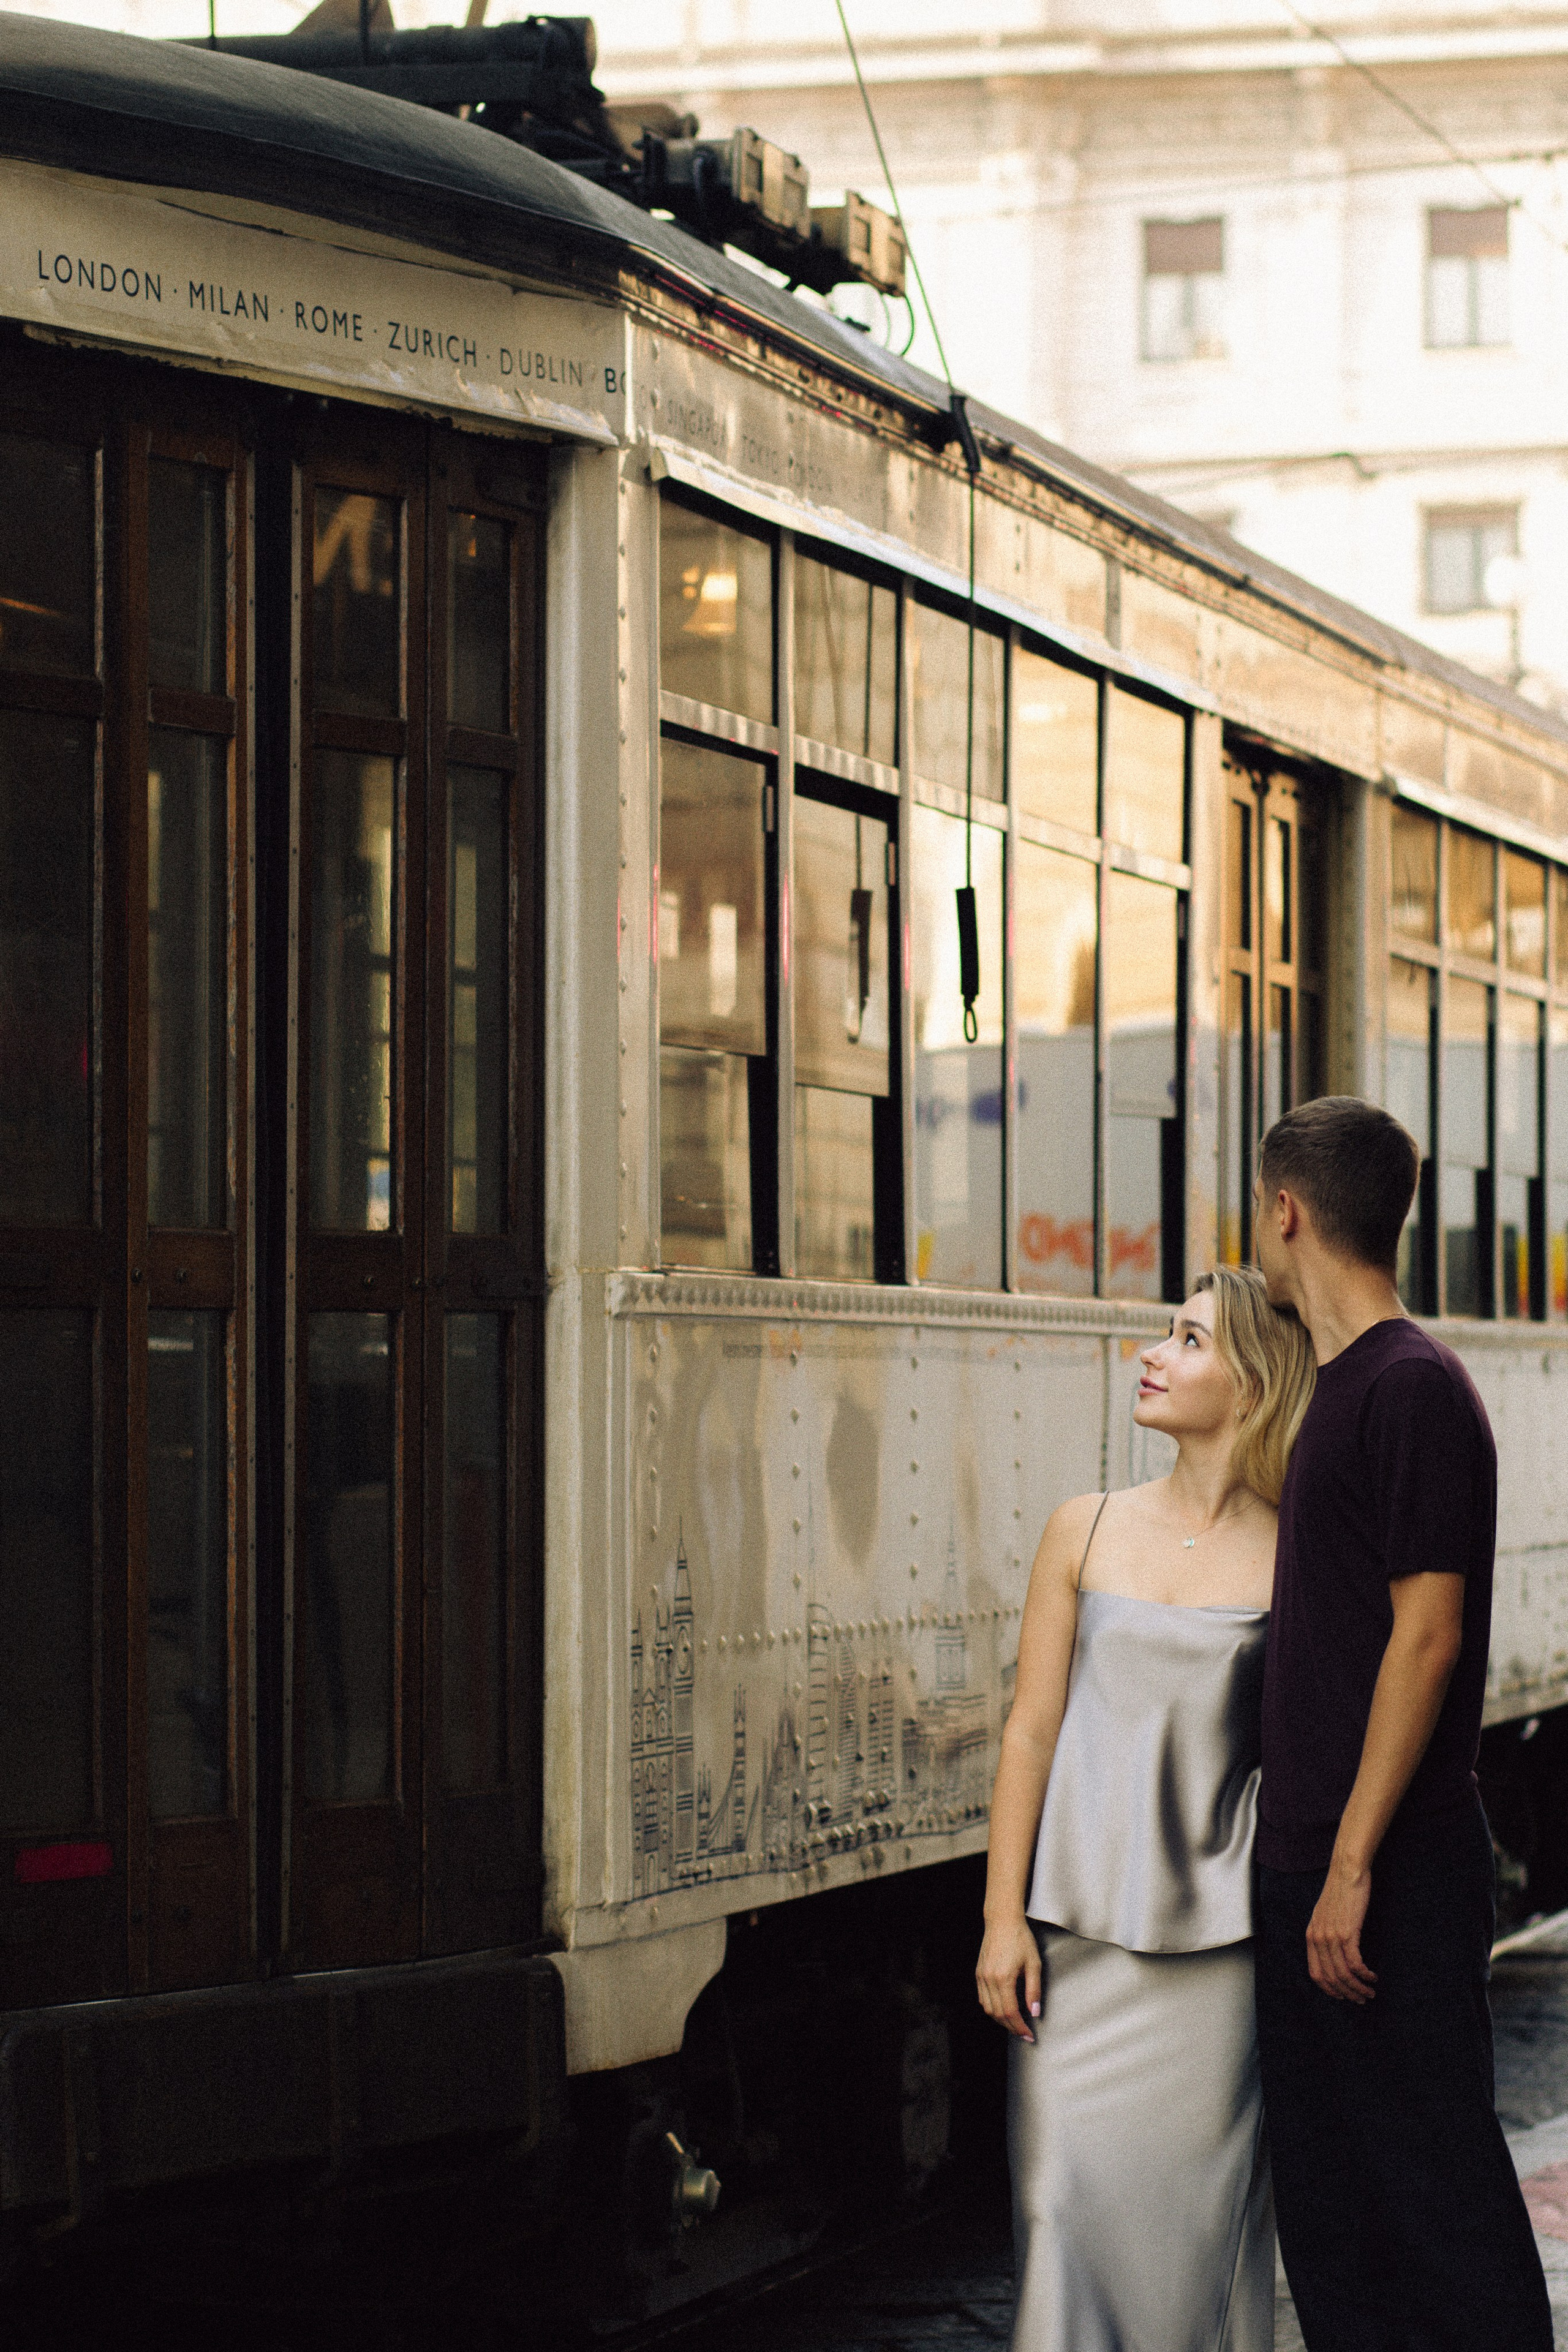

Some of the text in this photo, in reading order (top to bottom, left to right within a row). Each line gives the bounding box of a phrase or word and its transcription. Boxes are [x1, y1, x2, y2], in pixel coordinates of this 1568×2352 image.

[38, 249, 162, 303] LONDON
[189, 280, 269, 323] MILAN
[295, 301, 363, 342] ROME
[387, 320, 478, 368] ZURICH
[499, 347, 583, 388] DUBLIN
